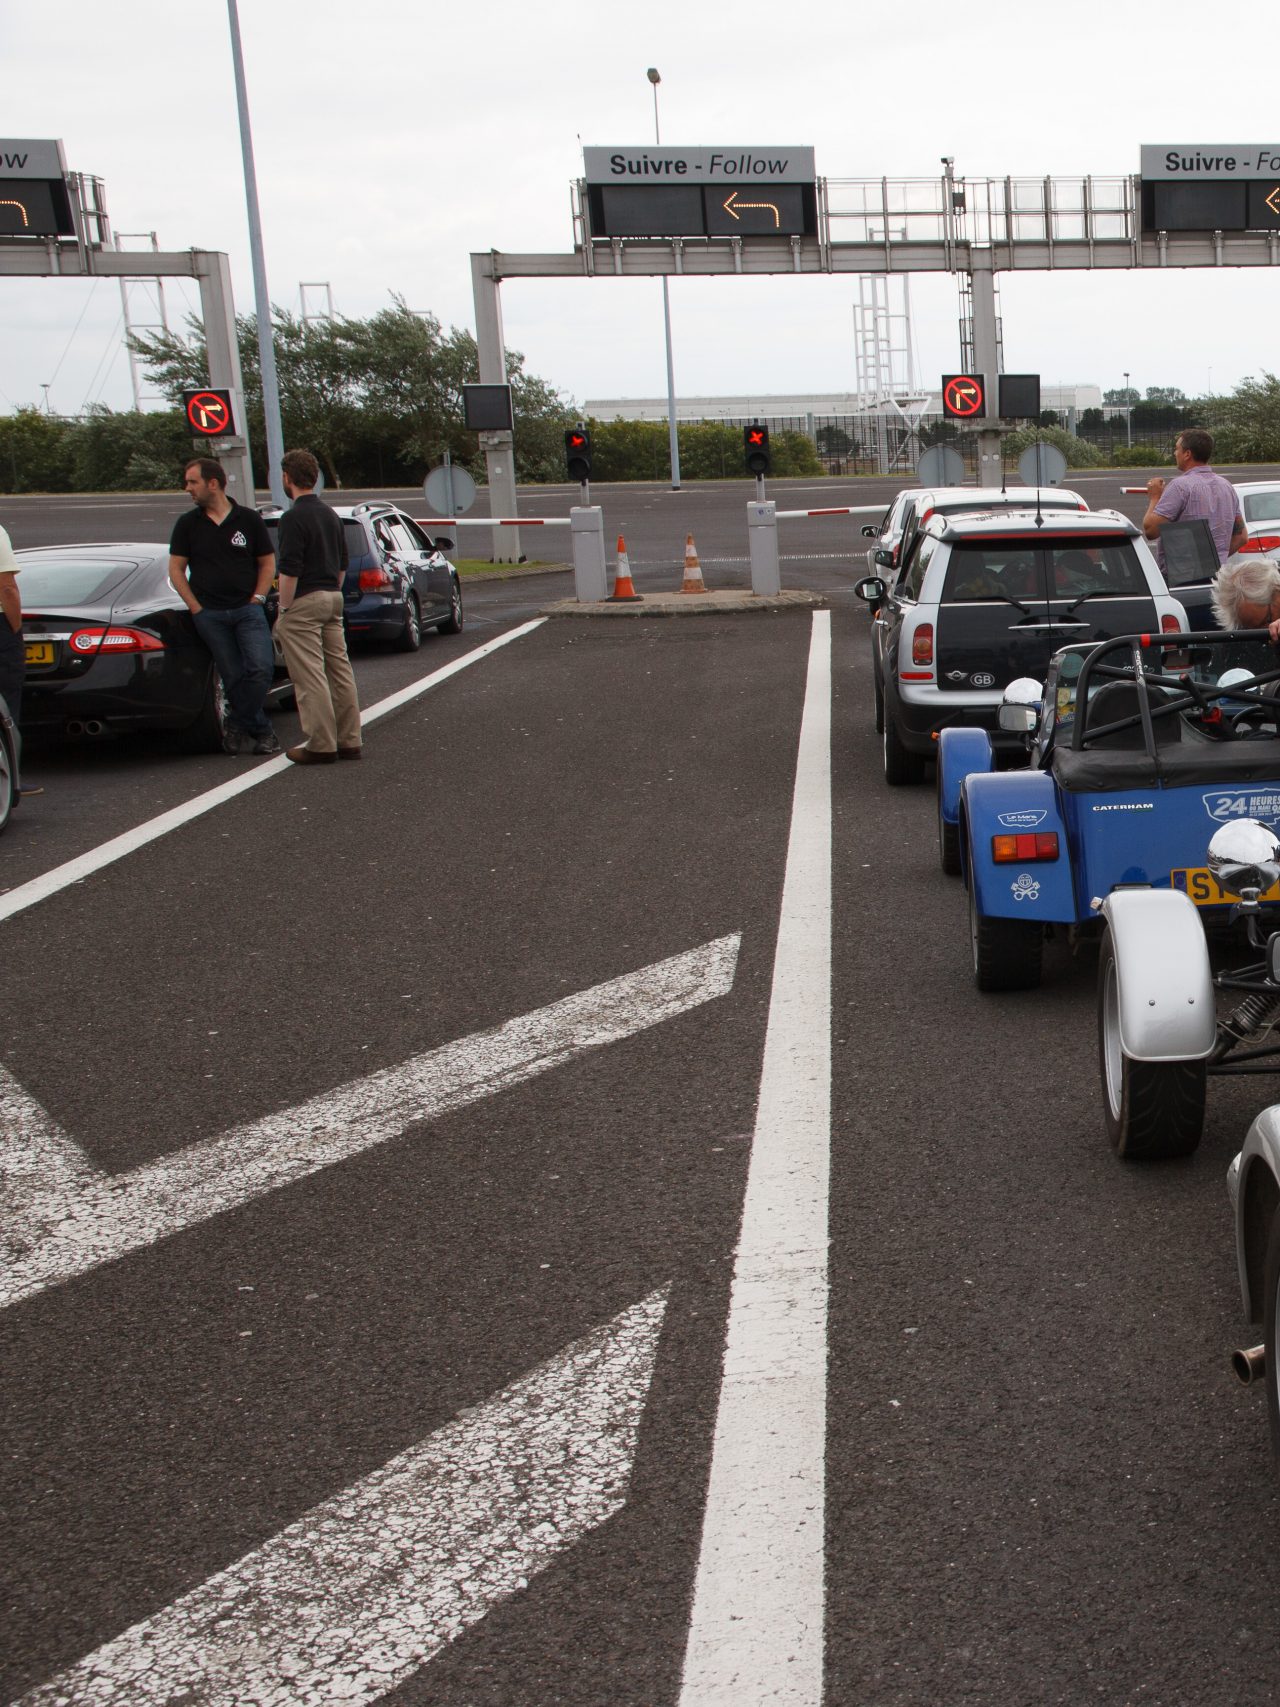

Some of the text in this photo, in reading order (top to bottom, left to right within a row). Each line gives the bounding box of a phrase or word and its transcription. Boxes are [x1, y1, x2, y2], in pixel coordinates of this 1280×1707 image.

[0, 153, 28, 168] w
[610, 155, 688, 175] Suivre
[709, 155, 788, 175] Follow
[1165, 152, 1236, 172] Suivre
[974, 675, 991, 685] GB
[1092, 803, 1154, 811] CATERHAM
[1213, 797, 1247, 816] 24
